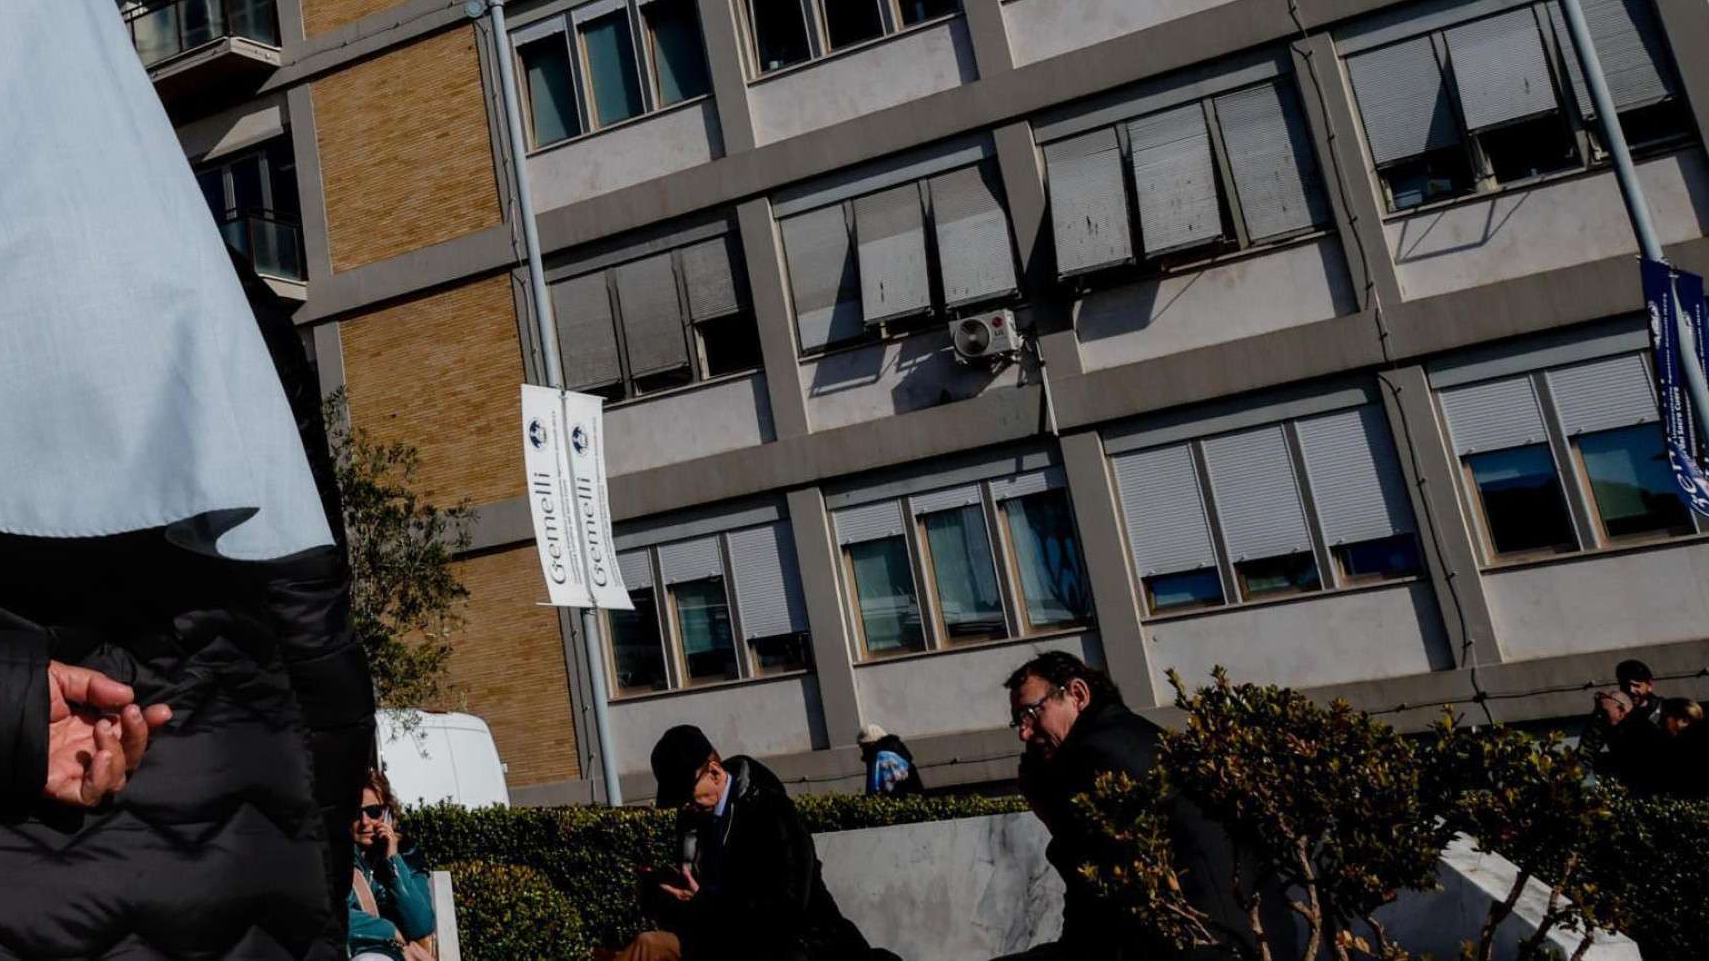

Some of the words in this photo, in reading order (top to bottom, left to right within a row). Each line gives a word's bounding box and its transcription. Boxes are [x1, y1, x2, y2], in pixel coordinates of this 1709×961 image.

[1673, 387, 1681, 413] Cuore
[534, 472, 566, 585] Gemelli
[577, 477, 607, 587] Gemelli
